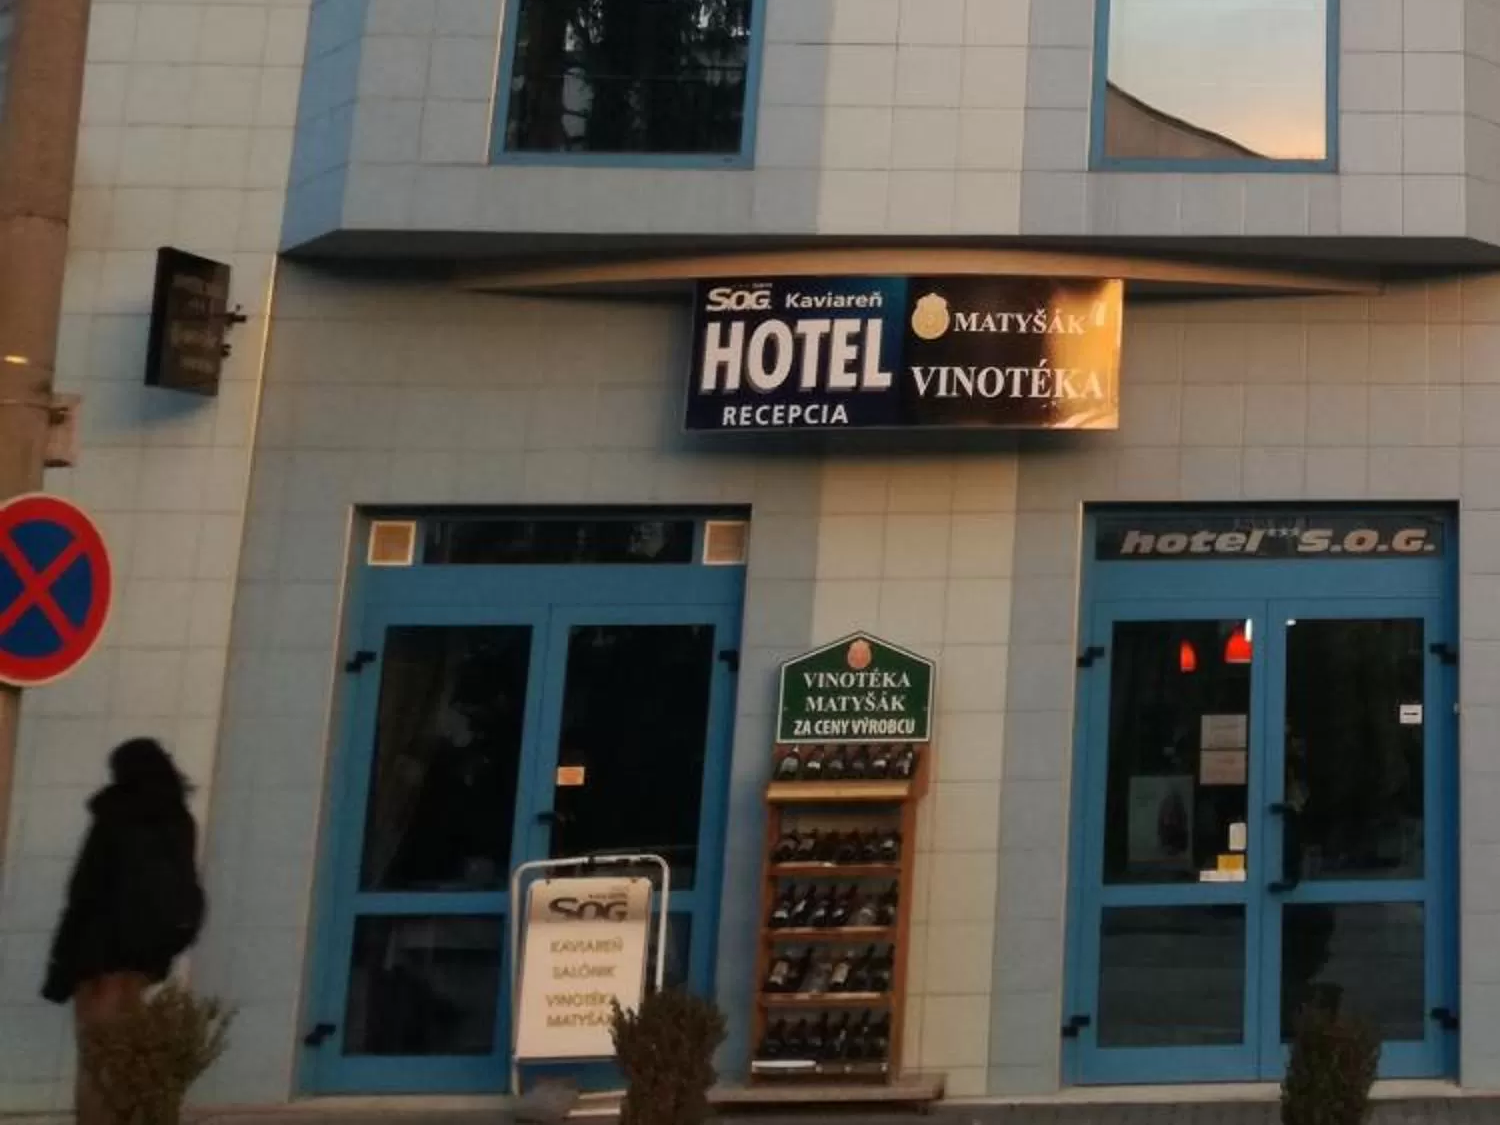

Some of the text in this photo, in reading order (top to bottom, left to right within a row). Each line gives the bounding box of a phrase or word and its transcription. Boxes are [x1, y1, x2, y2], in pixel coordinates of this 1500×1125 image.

[785, 291, 883, 309] Kaviareň
[954, 307, 1087, 335] MATYŠÁK
[700, 318, 893, 394] HOTEL
[910, 359, 1104, 400] VINOTÉKA
[722, 404, 849, 427] RECEPCIA
[1120, 528, 1436, 555] hotel S.O.G.
[803, 667, 912, 689] VINOTÉKA
[805, 691, 907, 712] MATYŠÁK
[793, 720, 811, 736] ZA
[814, 719, 849, 735] CENY
